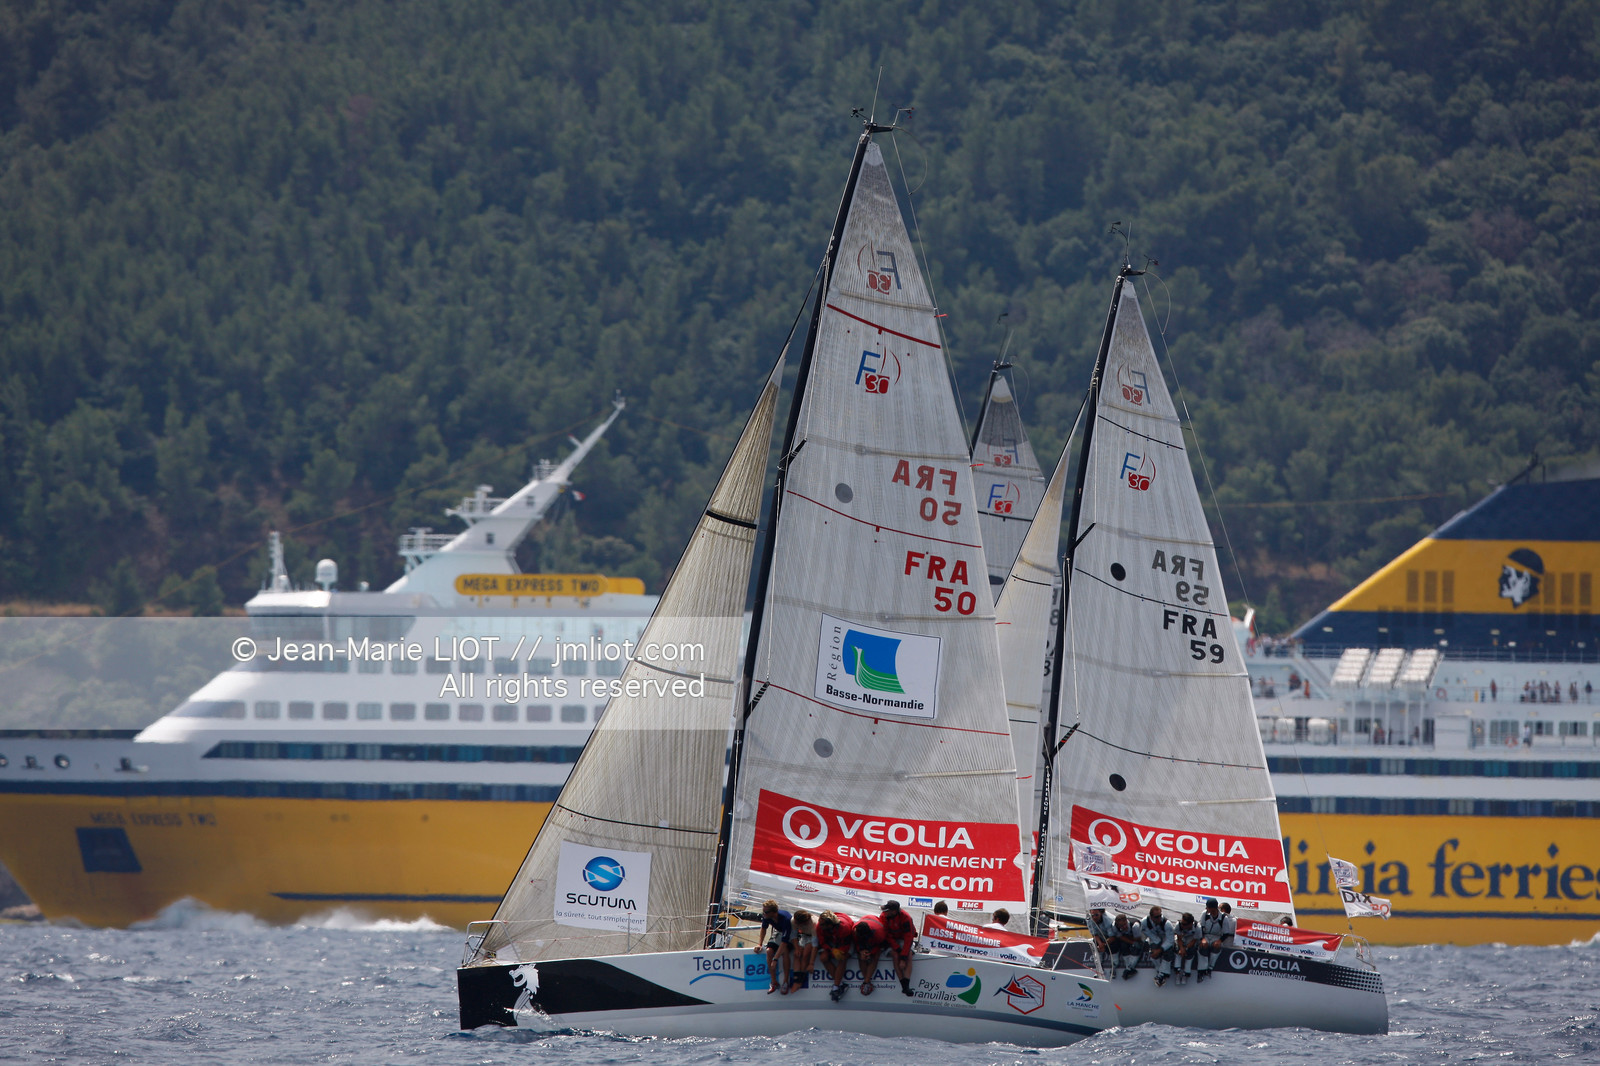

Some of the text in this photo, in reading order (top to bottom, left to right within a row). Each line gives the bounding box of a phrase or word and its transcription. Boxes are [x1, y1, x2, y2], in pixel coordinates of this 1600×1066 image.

[904, 550, 969, 586] FRA
[463, 578, 599, 592] MEGA EXPRESS TWO
[934, 586, 976, 616] 50
[1163, 609, 1217, 639] FRA
[826, 626, 841, 682] Région
[1190, 640, 1225, 664] 59
[825, 684, 924, 711] Basse-Normandie
[836, 815, 975, 850] VEOLIA
[1132, 826, 1250, 859] VEOLIA
[837, 845, 1007, 870] ENVIRONNEMENT
[1134, 852, 1277, 877] ENVIRONNEMENT
[1429, 838, 1600, 900] ferrie
[789, 855, 994, 892] canyousea.com
[1111, 862, 1268, 895] anyousea.com
[566, 893, 637, 910] SCUTUM
[929, 927, 1000, 948] BASSE NORMANDIE
[946, 920, 978, 935] MANCHE
[1247, 929, 1293, 944] DUNKERQUE
[1251, 922, 1290, 936] COURRIER
[937, 941, 954, 951] tour
[963, 945, 988, 956] france
[1000, 953, 1017, 961] voile
[1248, 940, 1262, 948] tour
[1269, 943, 1291, 952] france
[1299, 948, 1315, 956] voile
[1248, 969, 1307, 981] ENVIRONNEMENT
[1250, 956, 1301, 972] VEOLIA
[919, 979, 940, 991] Pays
[1075, 1002, 1099, 1010] MANCHE
